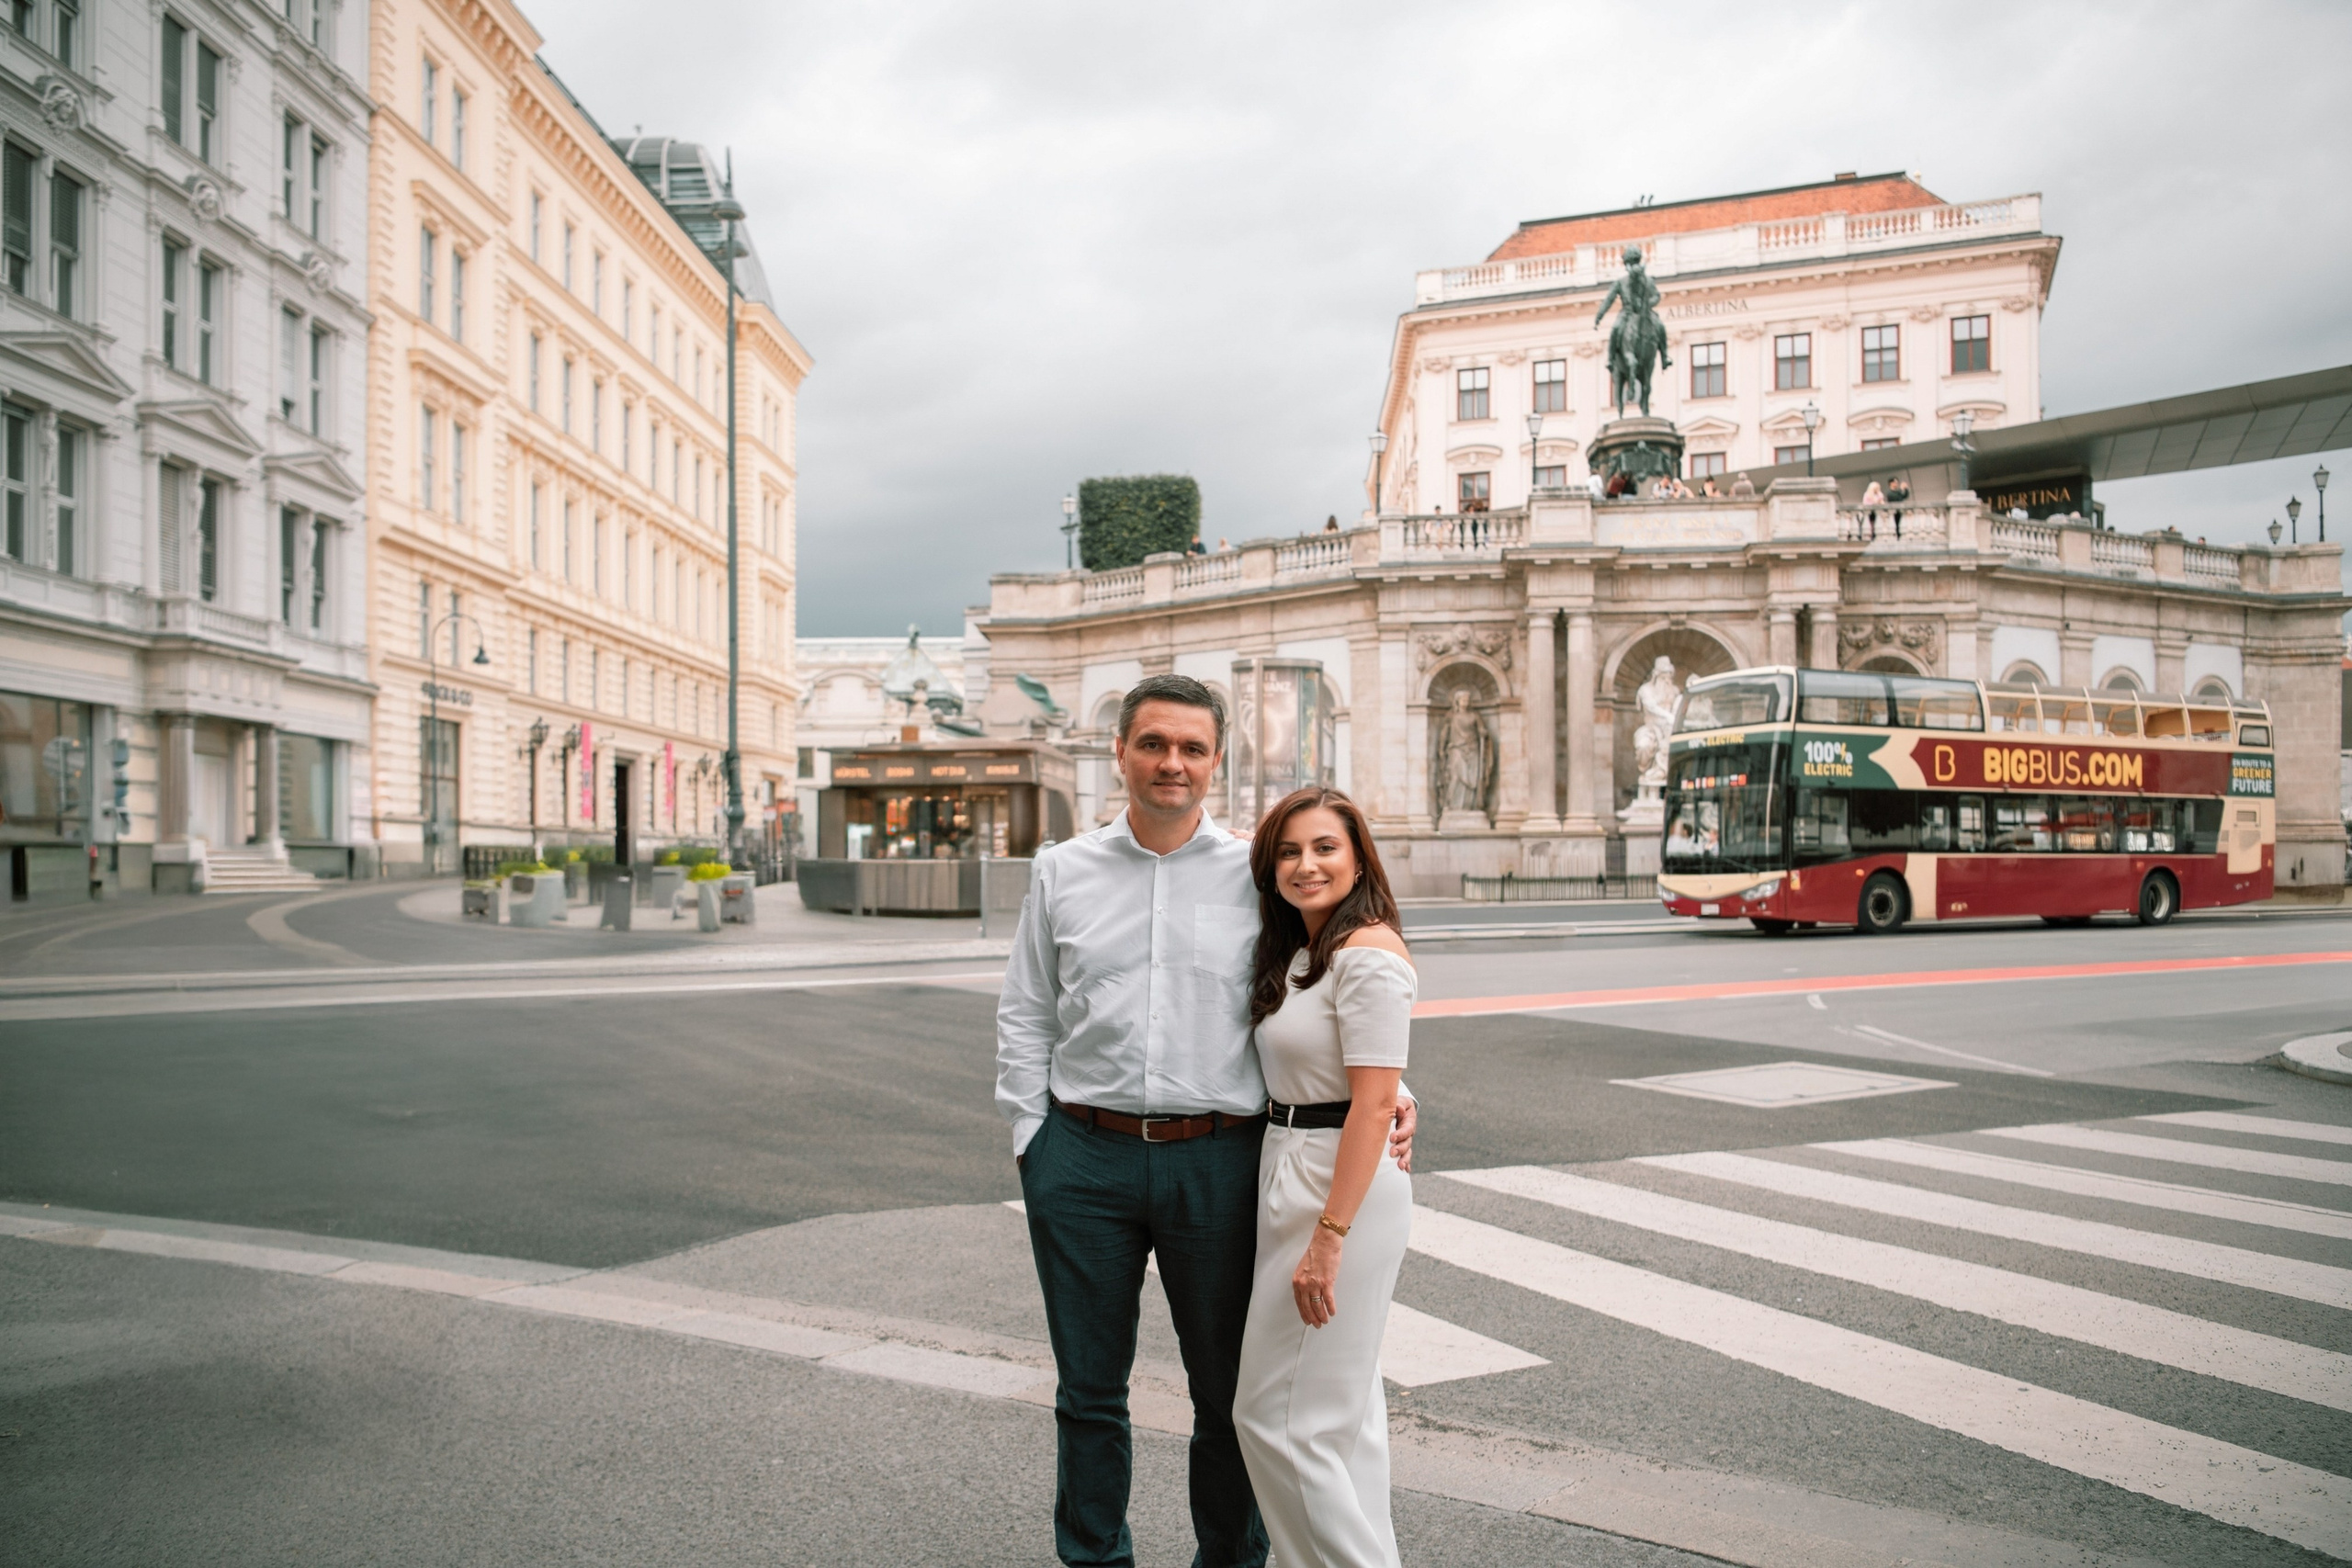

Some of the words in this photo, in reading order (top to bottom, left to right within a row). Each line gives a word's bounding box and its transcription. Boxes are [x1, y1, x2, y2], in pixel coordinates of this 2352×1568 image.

[1666, 299, 1749, 320] ALBERTINA
[1707, 734, 1745, 747] ELECTRIC
[1804, 740, 1853, 764] 100%
[1804, 762, 1853, 777] ELECTRIC
[1983, 747, 2143, 787] BIGBUS.COM
[2232, 758, 2240, 766] EN
[2241, 759, 2258, 767] ROUTE
[2259, 759, 2267, 768] TO
[2233, 767, 2272, 779] GREENER
[2232, 778, 2273, 794] FUTURE
